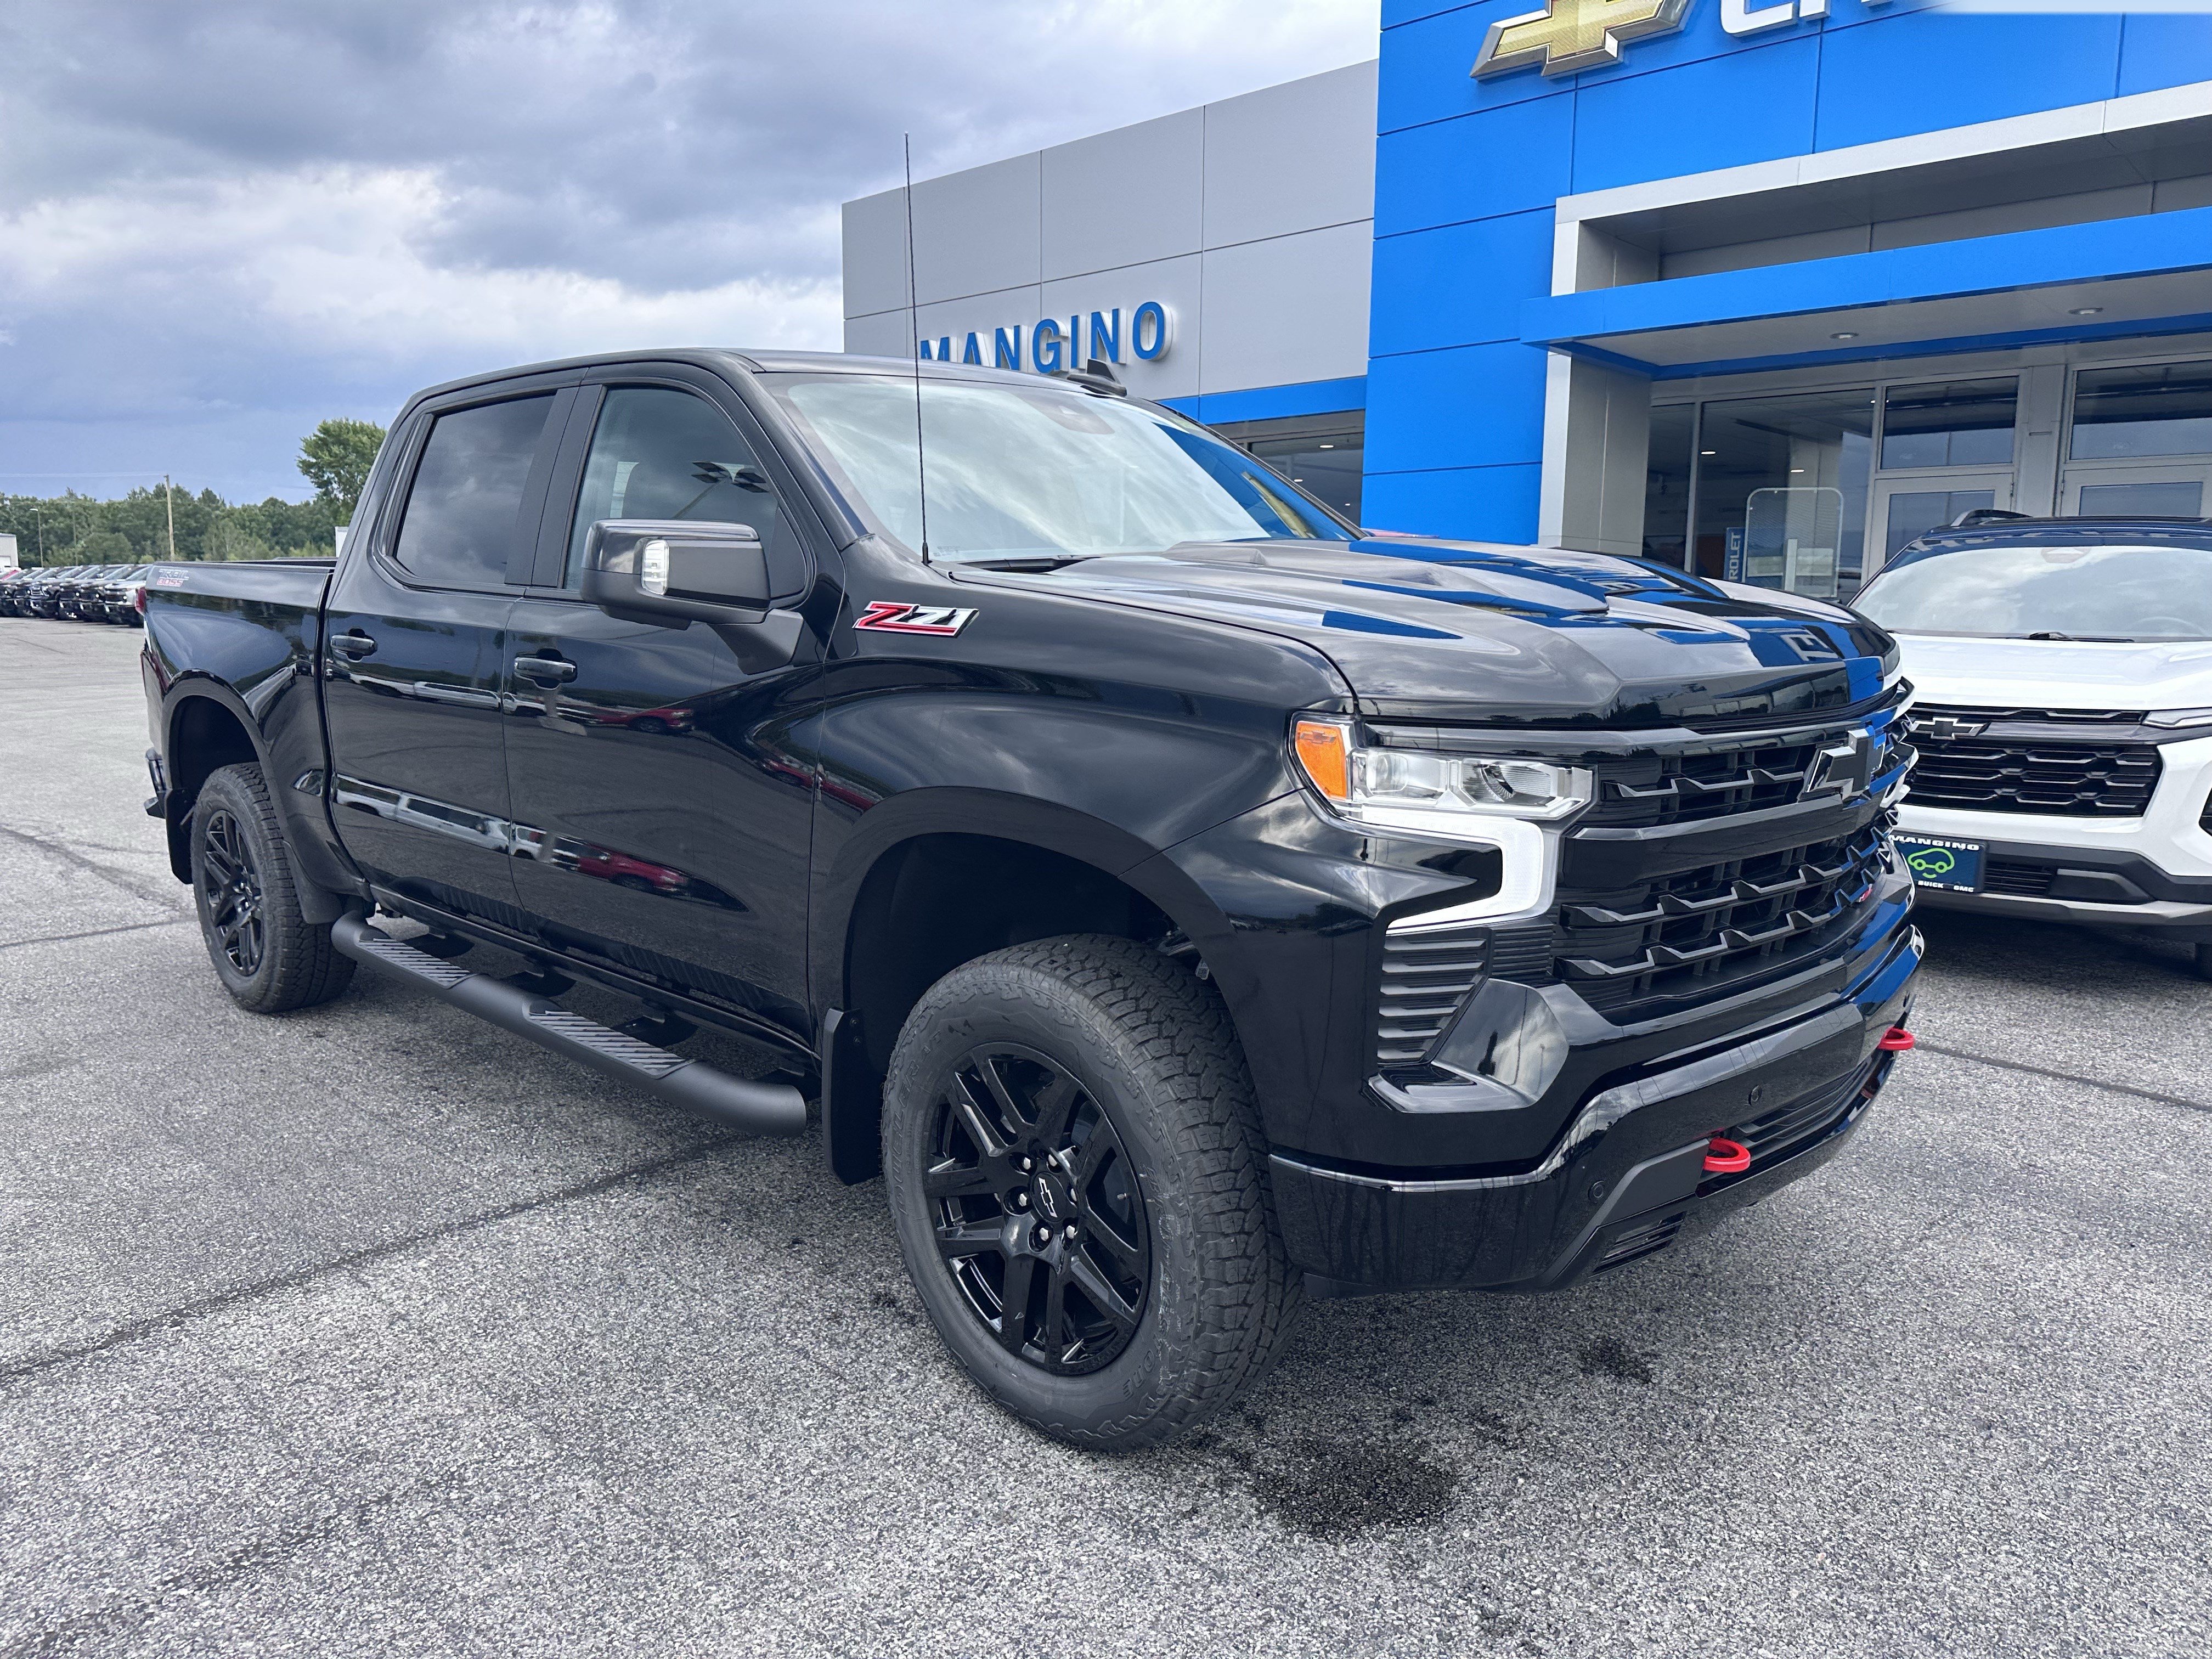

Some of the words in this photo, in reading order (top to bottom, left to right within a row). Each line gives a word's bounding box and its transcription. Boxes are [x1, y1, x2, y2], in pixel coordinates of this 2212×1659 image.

[158, 568, 190, 580] TRAIL
[156, 577, 184, 587] BOSS
[852, 601, 979, 637] Z71
[1888, 834, 1979, 851] MANGINO
[1918, 880, 1944, 889] BUICK
